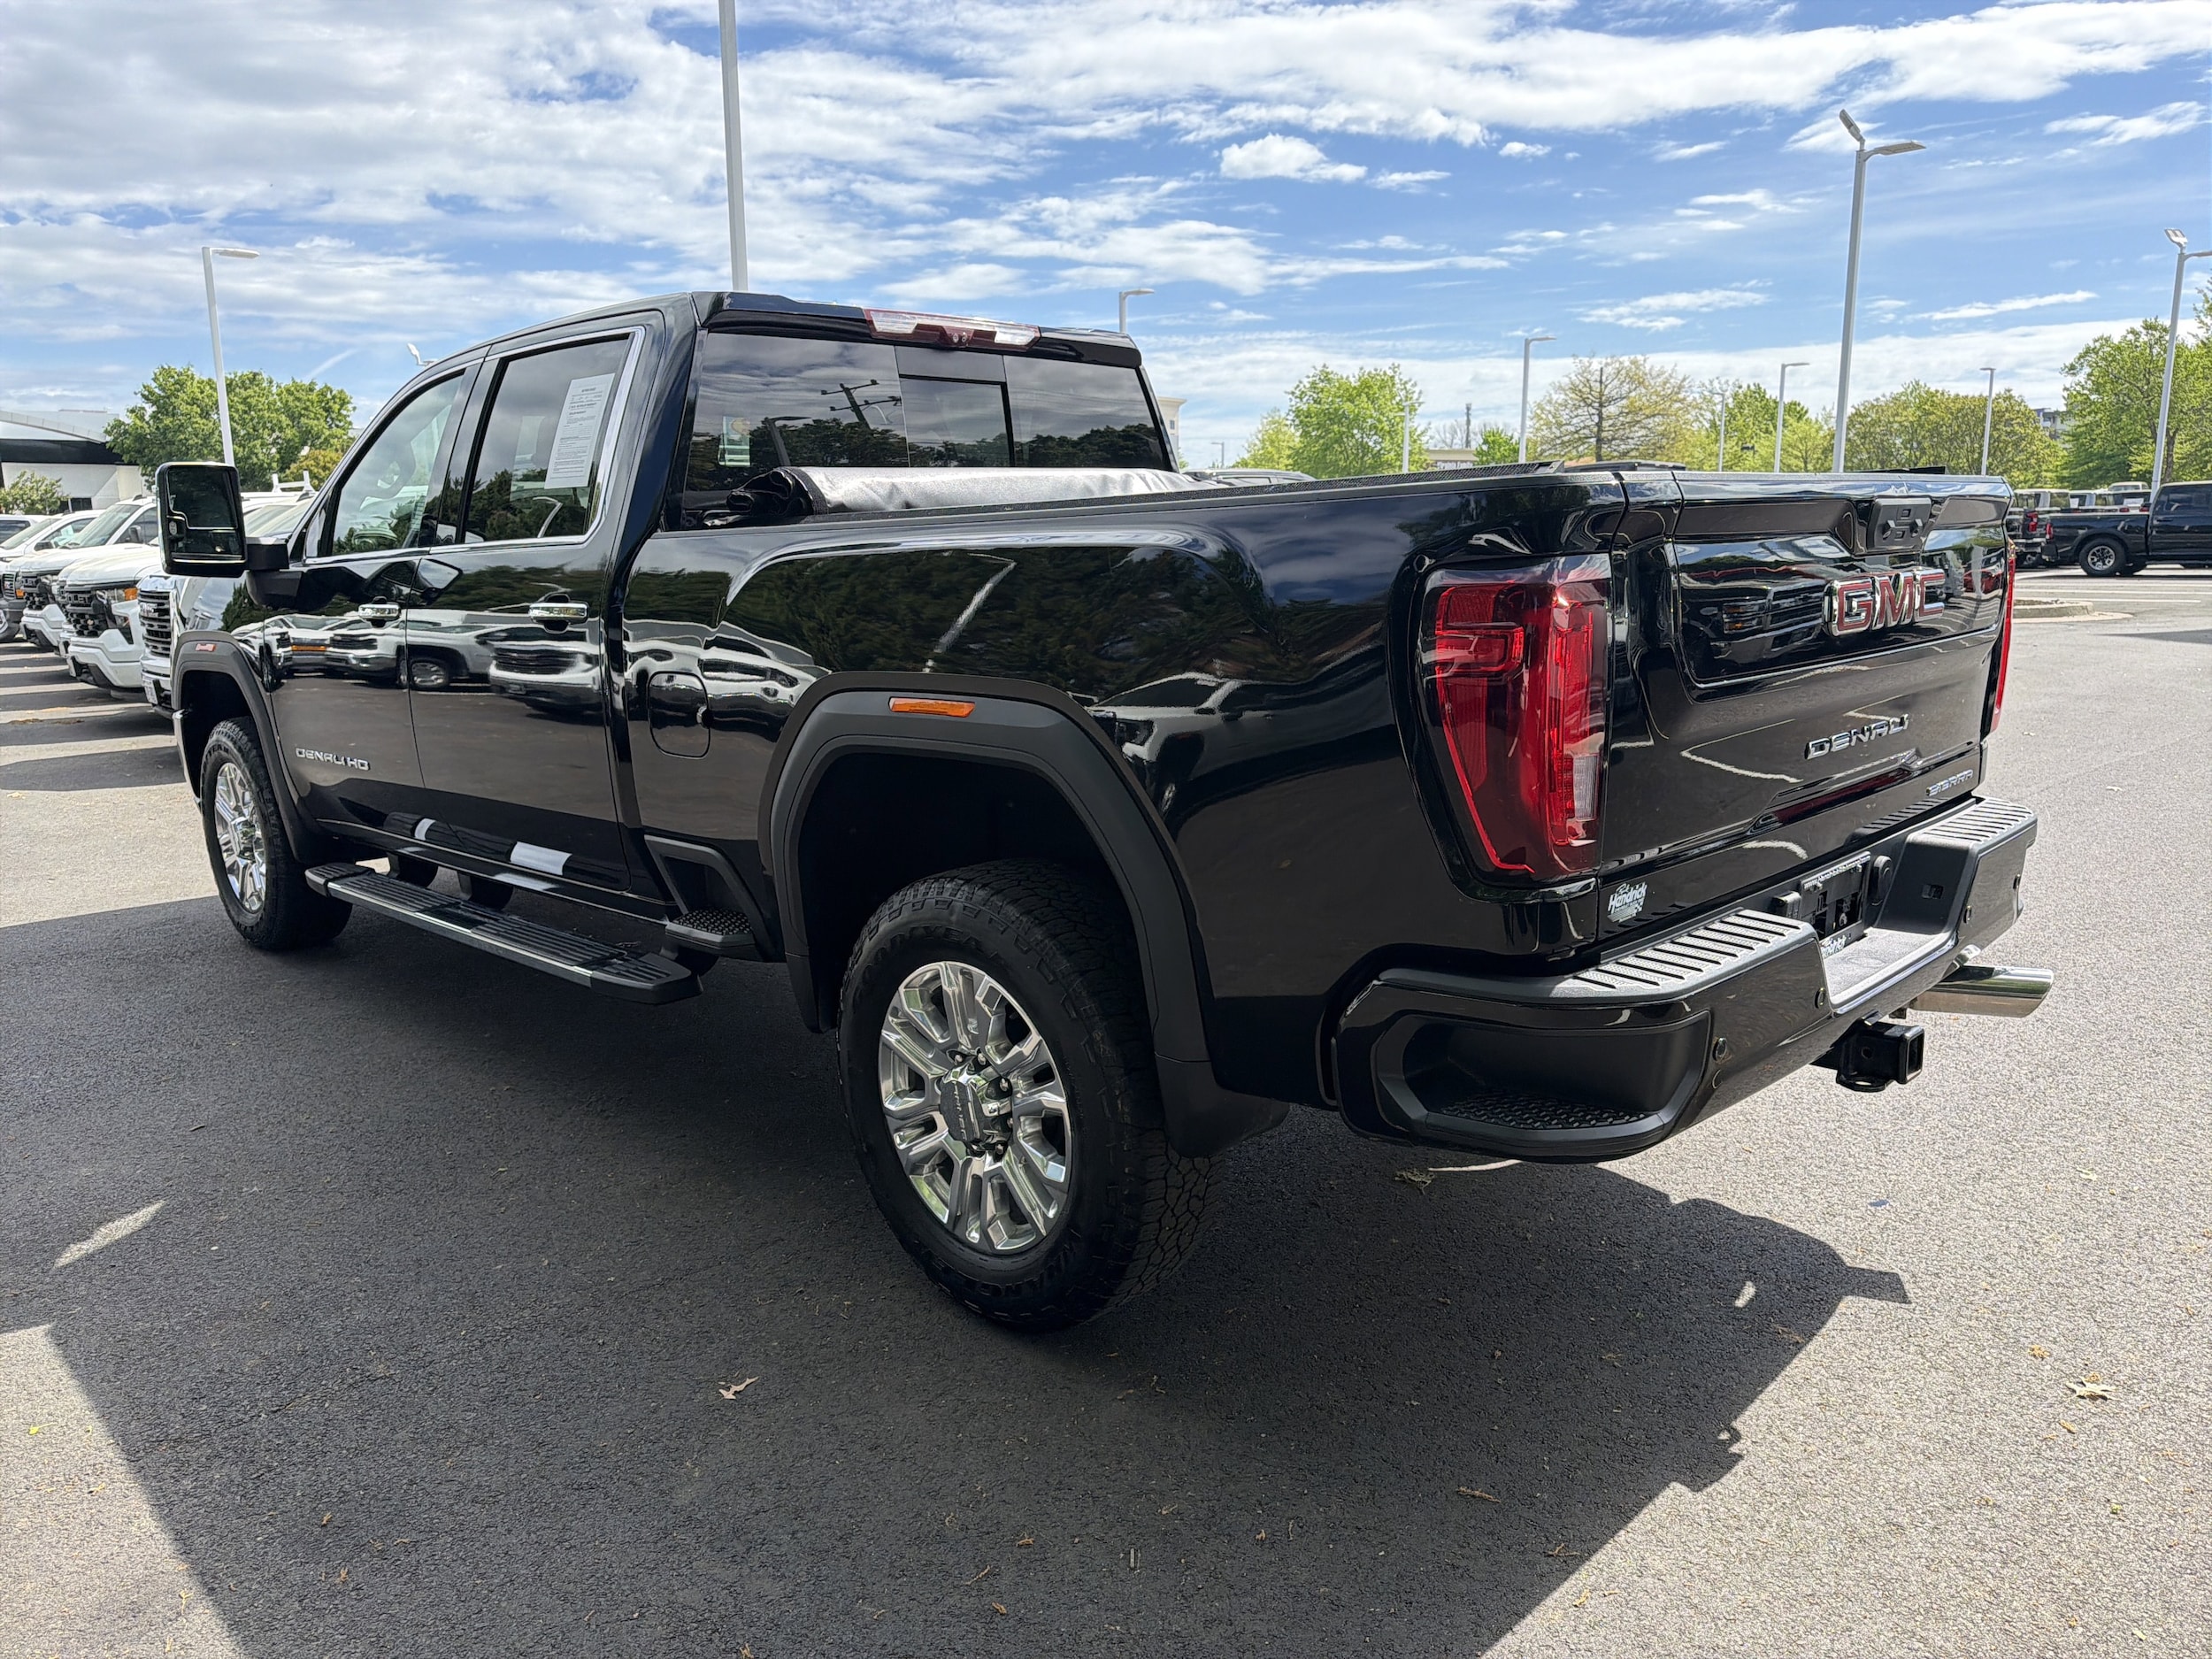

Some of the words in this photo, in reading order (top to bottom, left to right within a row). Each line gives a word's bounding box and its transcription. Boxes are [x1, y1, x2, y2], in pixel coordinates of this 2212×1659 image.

[1823, 569, 1946, 636] GMC
[1805, 713, 1909, 759] DENALI
[296, 748, 345, 766] DENALI
[346, 757, 370, 771] HD
[1926, 769, 1973, 796] SIERRA
